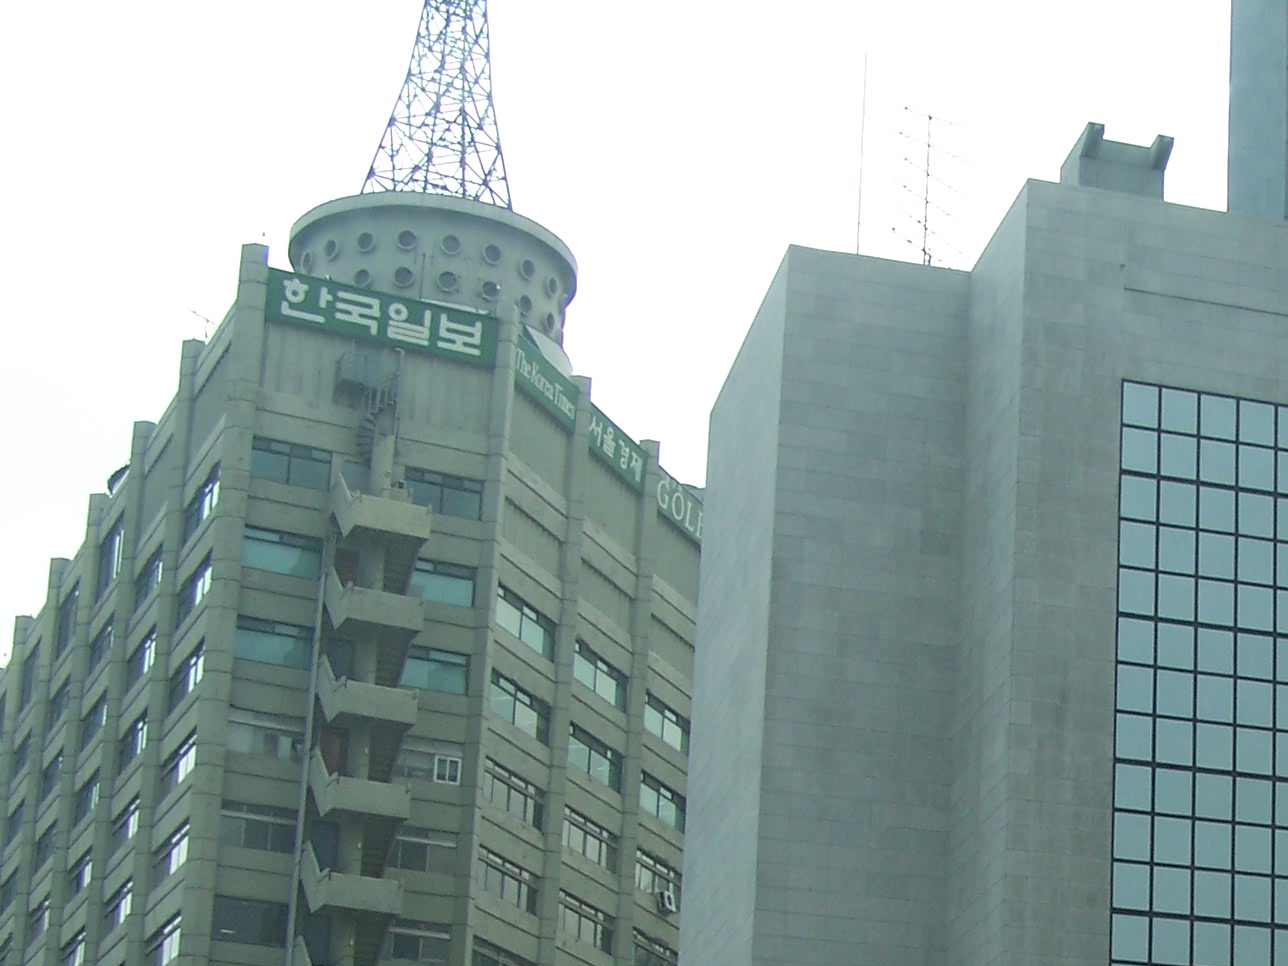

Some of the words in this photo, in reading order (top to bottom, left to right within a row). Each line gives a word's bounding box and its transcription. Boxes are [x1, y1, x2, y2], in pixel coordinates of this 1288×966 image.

[281, 278, 483, 357] 한국일보
[515, 347, 531, 379] The
[530, 361, 554, 400] Korea
[553, 382, 576, 420] Times
[589, 416, 644, 482] 서울경제
